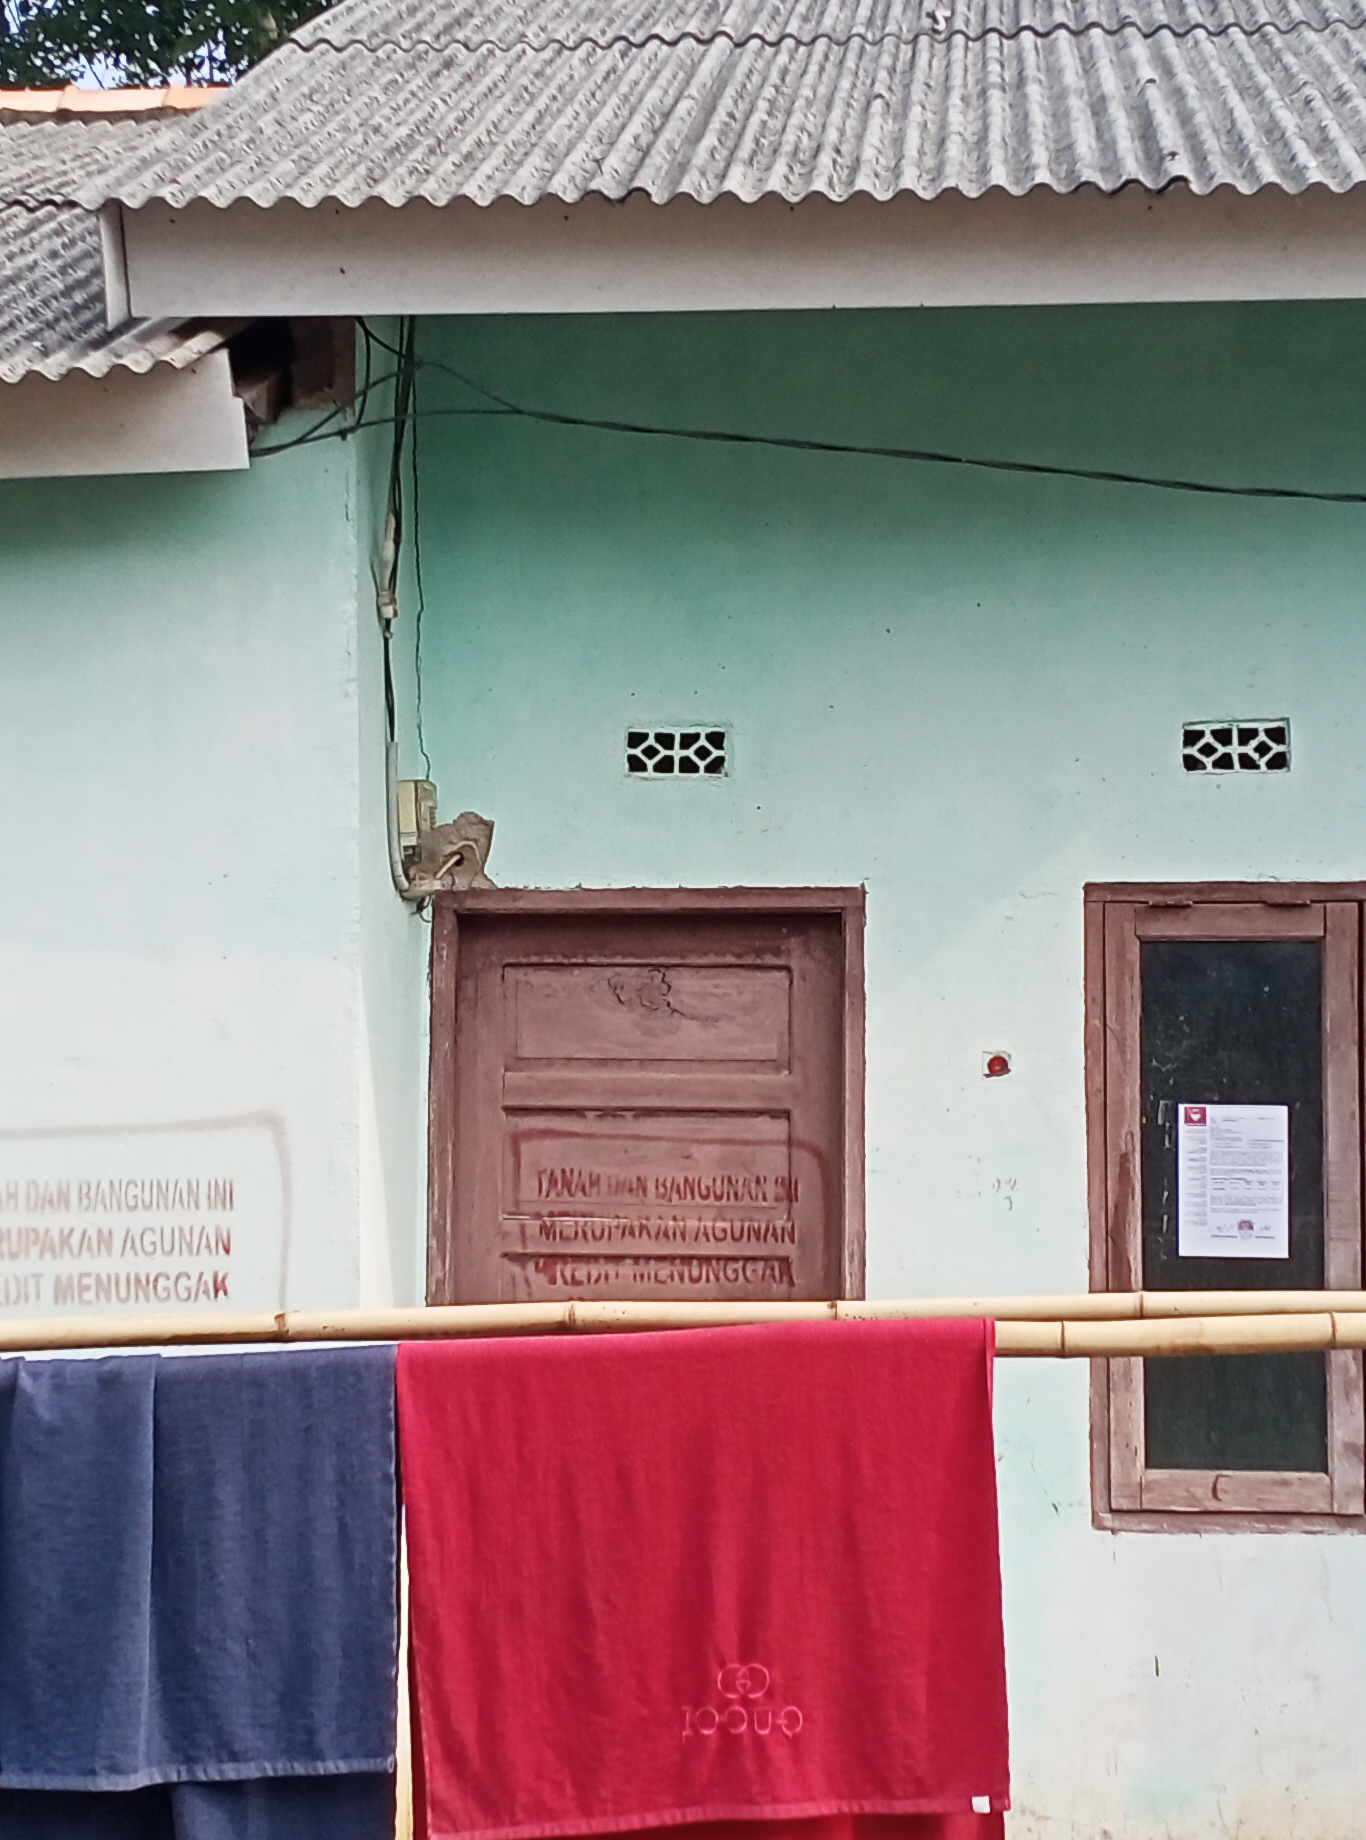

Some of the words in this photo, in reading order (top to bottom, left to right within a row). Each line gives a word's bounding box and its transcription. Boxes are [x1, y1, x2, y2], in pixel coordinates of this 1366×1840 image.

[25, 1179, 71, 1215] DAN
[78, 1179, 200, 1213] BANGUNAN
[207, 1178, 234, 1212] INI
[537, 1167, 601, 1198] TANAH
[655, 1174, 768, 1203] BANGUNAN
[121, 1225, 232, 1259] AGUNAN
[538, 1210, 687, 1243] MERUPAKAN
[694, 1215, 796, 1245] AGUNAN
[53, 1270, 230, 1307] MENUNGGAK
